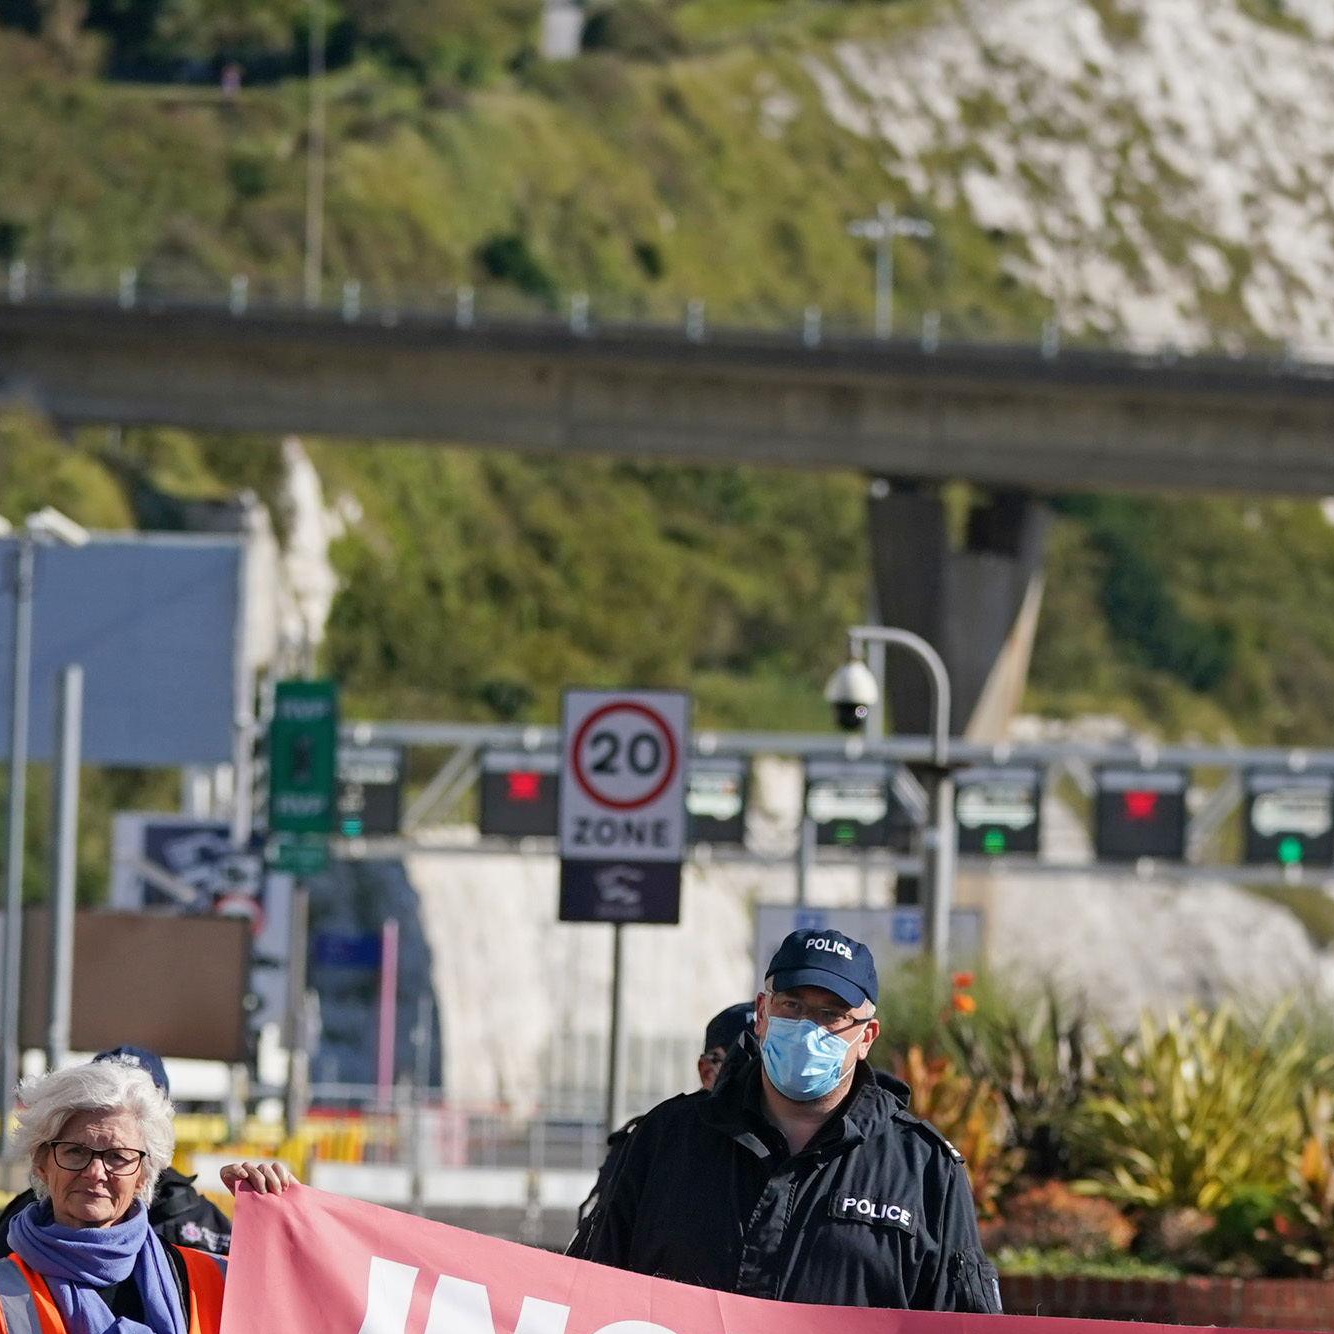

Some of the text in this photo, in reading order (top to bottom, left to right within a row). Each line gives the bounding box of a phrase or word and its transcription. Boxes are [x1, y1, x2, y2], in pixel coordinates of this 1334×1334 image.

[590, 731, 660, 775] 20
[573, 817, 670, 846] ZONE
[805, 938, 853, 961] POLICE
[842, 1198, 912, 1226] POLICE
